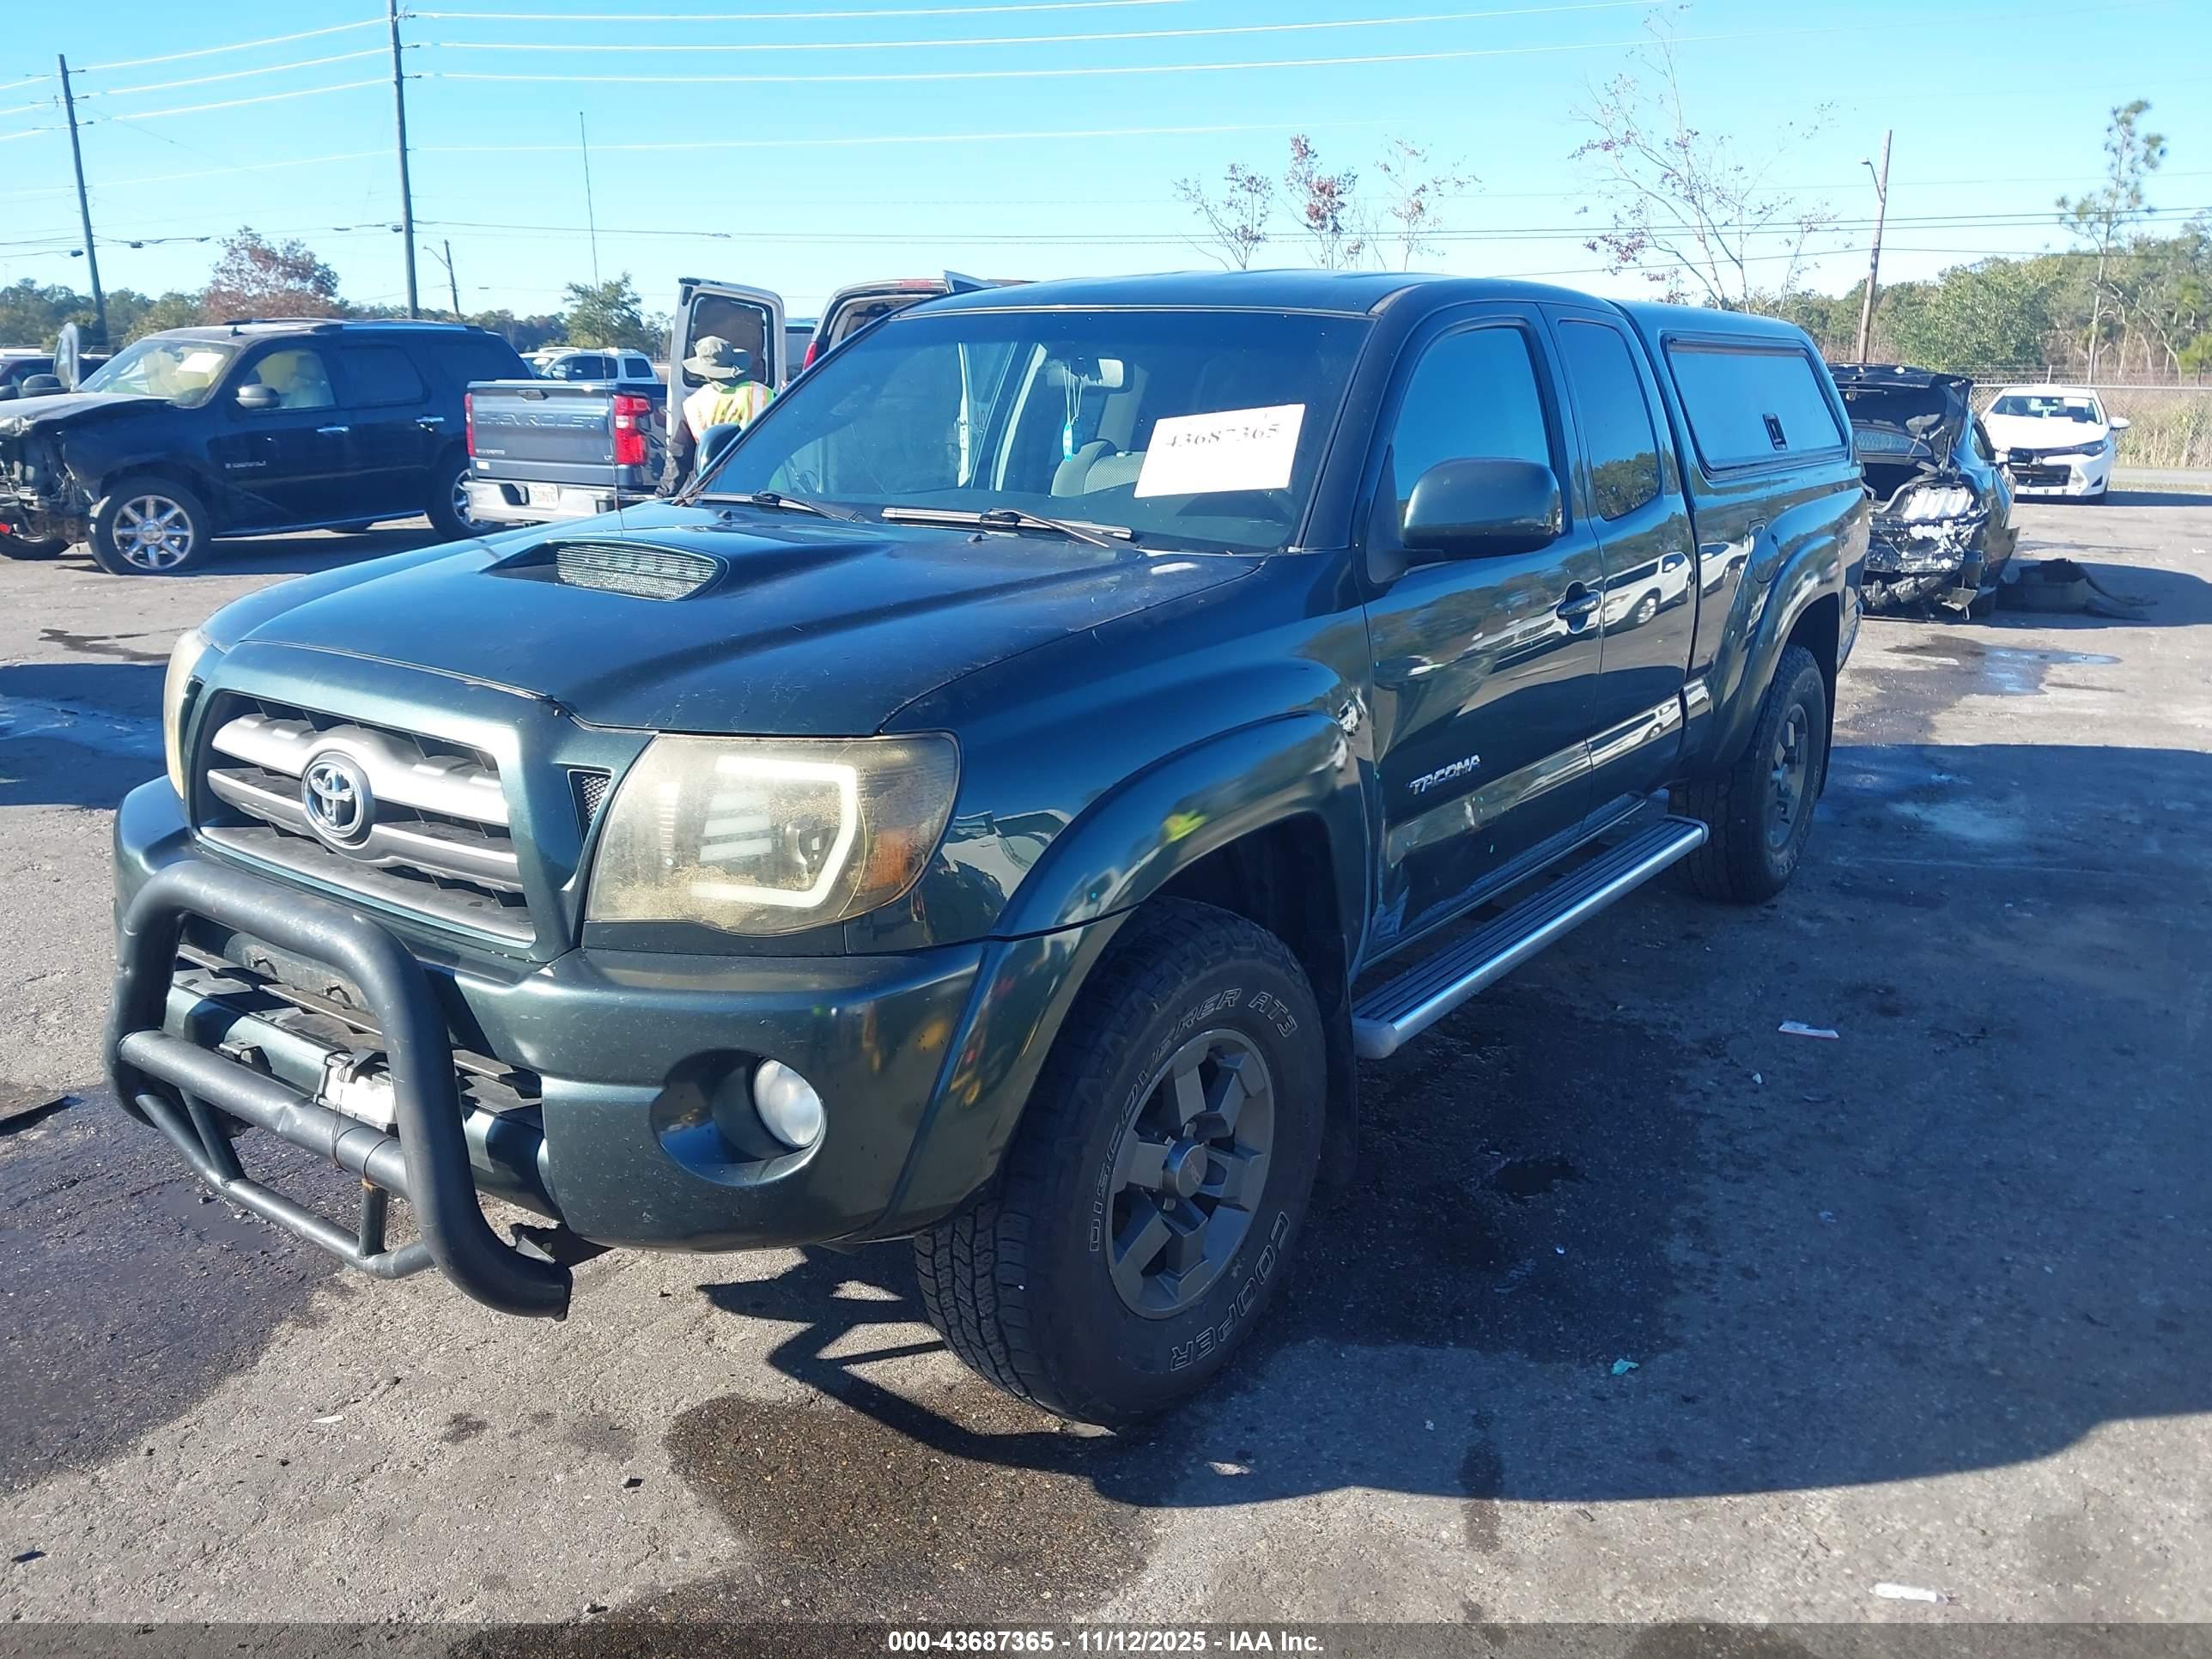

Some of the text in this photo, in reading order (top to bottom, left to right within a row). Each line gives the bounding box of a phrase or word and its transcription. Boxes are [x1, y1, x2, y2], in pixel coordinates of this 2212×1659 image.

[1409, 754, 1481, 795] TACOMA
[1089, 988, 1298, 1252] DISCOVERER AT3
[1170, 1211, 1290, 1373] COOPER
